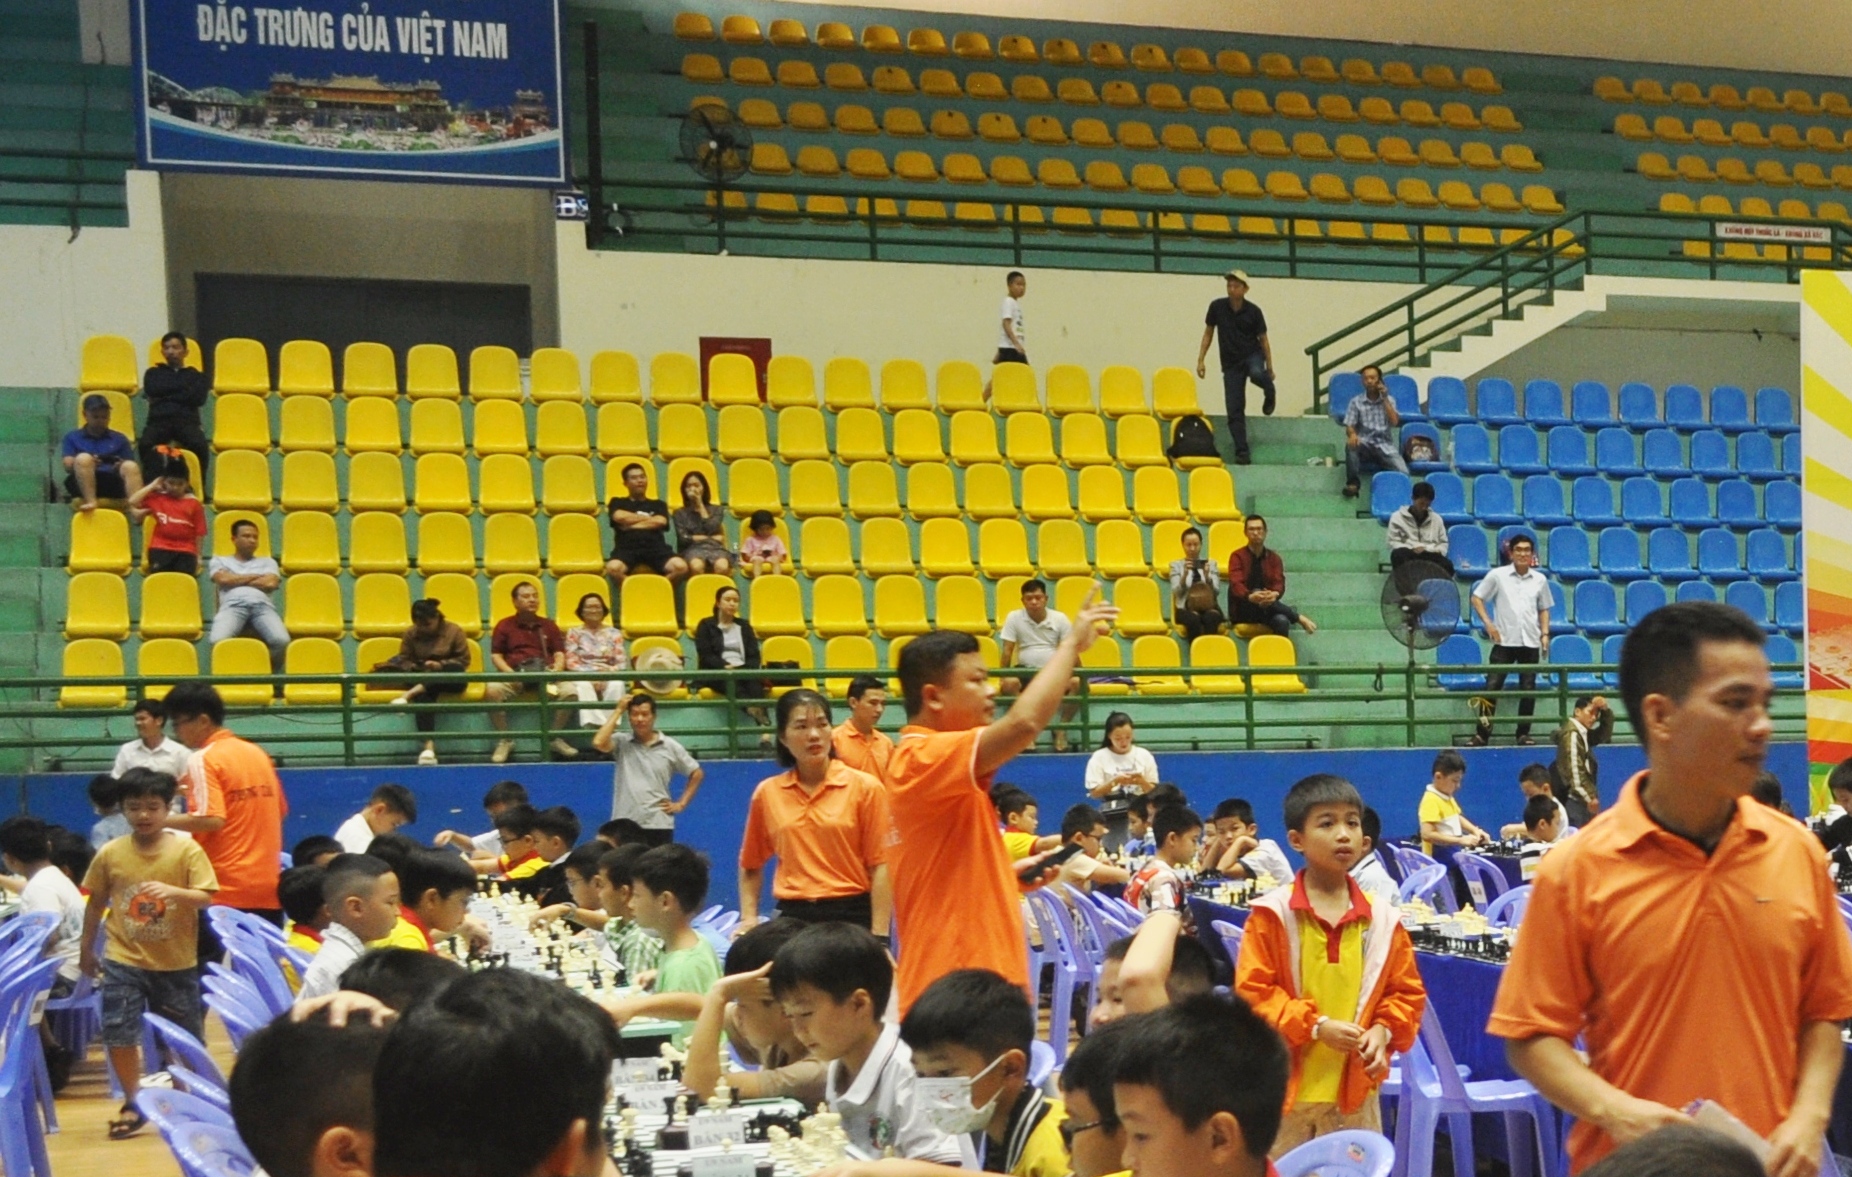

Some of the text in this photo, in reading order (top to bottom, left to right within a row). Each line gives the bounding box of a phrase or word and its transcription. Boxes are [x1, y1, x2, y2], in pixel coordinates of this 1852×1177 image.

[197, 0, 508, 63] ĐẶC TRƯNG CỦA VIỆT NAM
